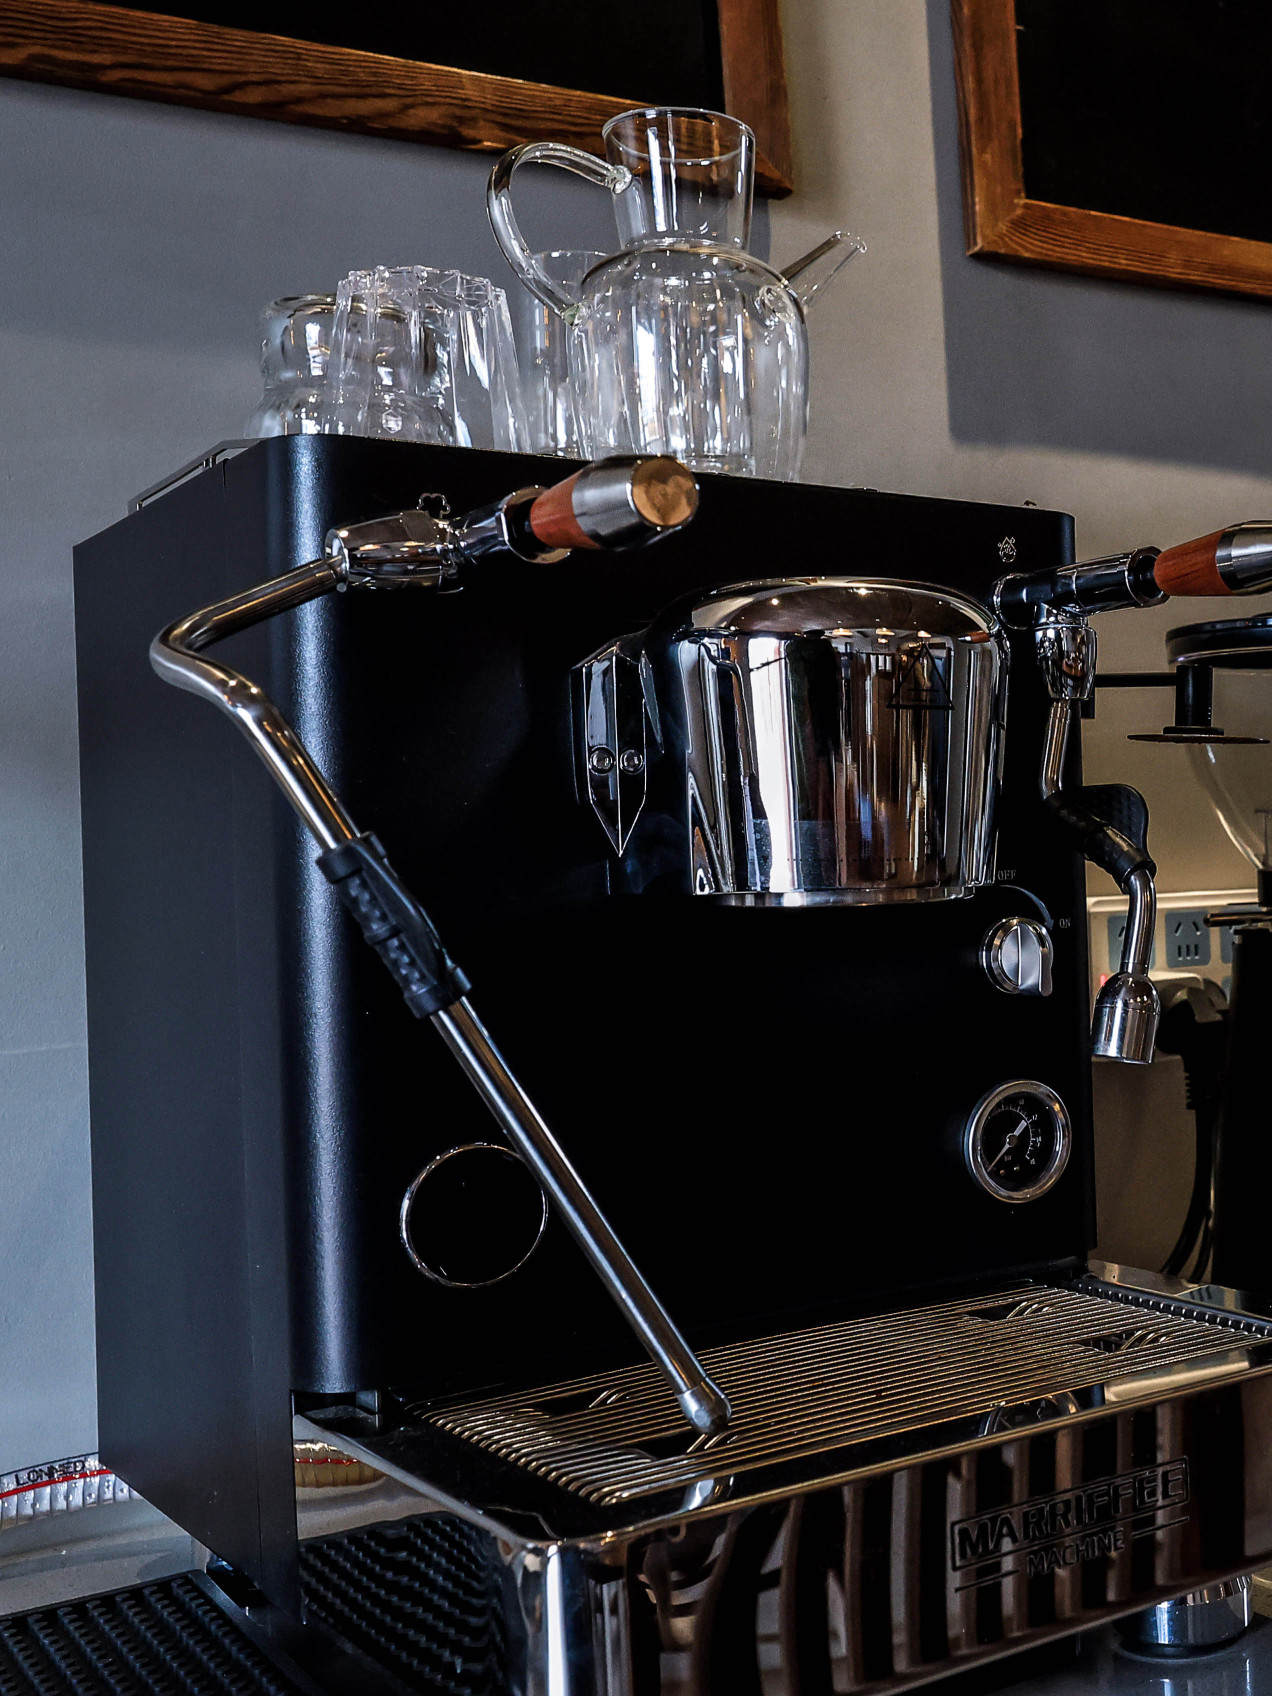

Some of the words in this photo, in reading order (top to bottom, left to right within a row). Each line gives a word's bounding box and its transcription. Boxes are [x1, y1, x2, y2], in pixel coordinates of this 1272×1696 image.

[997, 869, 1017, 881] OFF
[1059, 917, 1071, 929] ON
[957, 1465, 1184, 1560] MARRIFFEE
[1026, 1527, 1126, 1577] MACHINE
